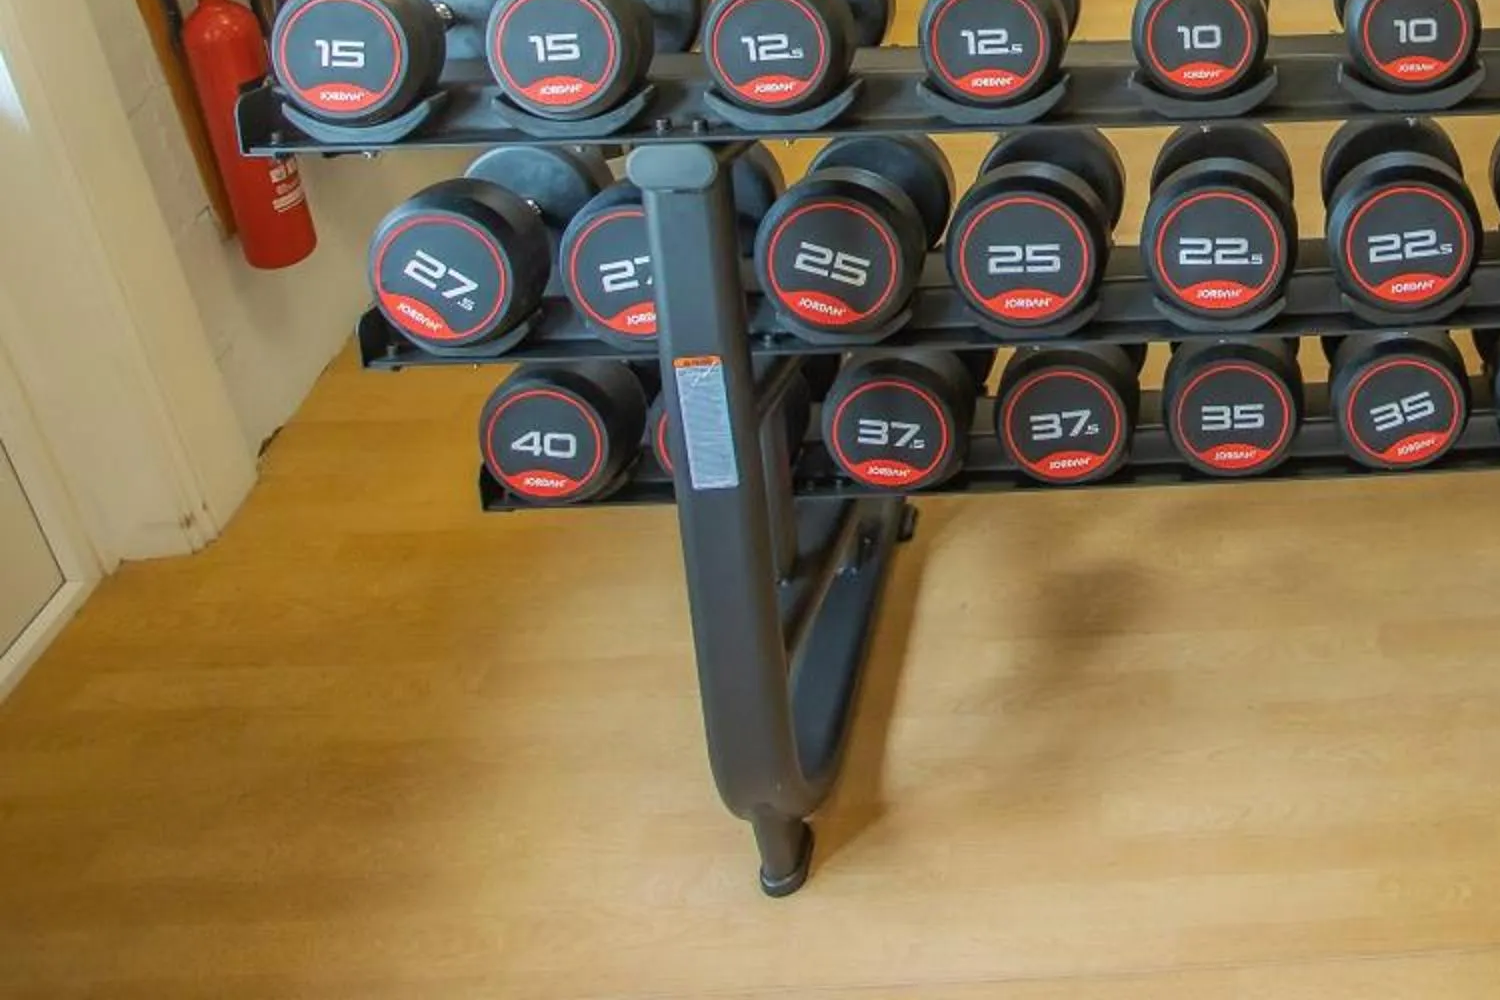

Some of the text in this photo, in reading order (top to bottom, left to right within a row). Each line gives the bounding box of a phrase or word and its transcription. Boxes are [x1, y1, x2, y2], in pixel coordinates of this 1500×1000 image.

[1177, 24, 1221, 50] 10
[1393, 18, 1437, 43] 10
[315, 39, 365, 68] 15
[528, 33, 581, 62] 15
[1183, 70, 1221, 79] JORDAN
[1398, 63, 1434, 73] JORDAN
[754, 81, 795, 93] JORDAN
[971, 76, 1013, 87] JORDAN
[319, 91, 365, 101] JORDAN
[539, 83, 582, 95] JORDAN
[793, 241, 870, 287] 25
[988, 243, 1061, 274] 25
[1391, 279, 1435, 294] JORDAN
[1197, 289, 1242, 299] JORDAN
[798, 297, 843, 316] JORDAN
[1004, 297, 1052, 308] JORDAN
[397, 302, 444, 332] JORDAN
[627, 311, 657, 325] JORD
[1201, 403, 1265, 431] 35
[1369, 391, 1435, 432] 35
[511, 431, 577, 459] 40
[1397, 437, 1435, 457] JORDAN
[1214, 449, 1257, 461] JORDAN
[1049, 457, 1091, 469] JORDAN
[867, 466, 911, 477] JORDAN
[523, 477, 567, 488] JORDAN
